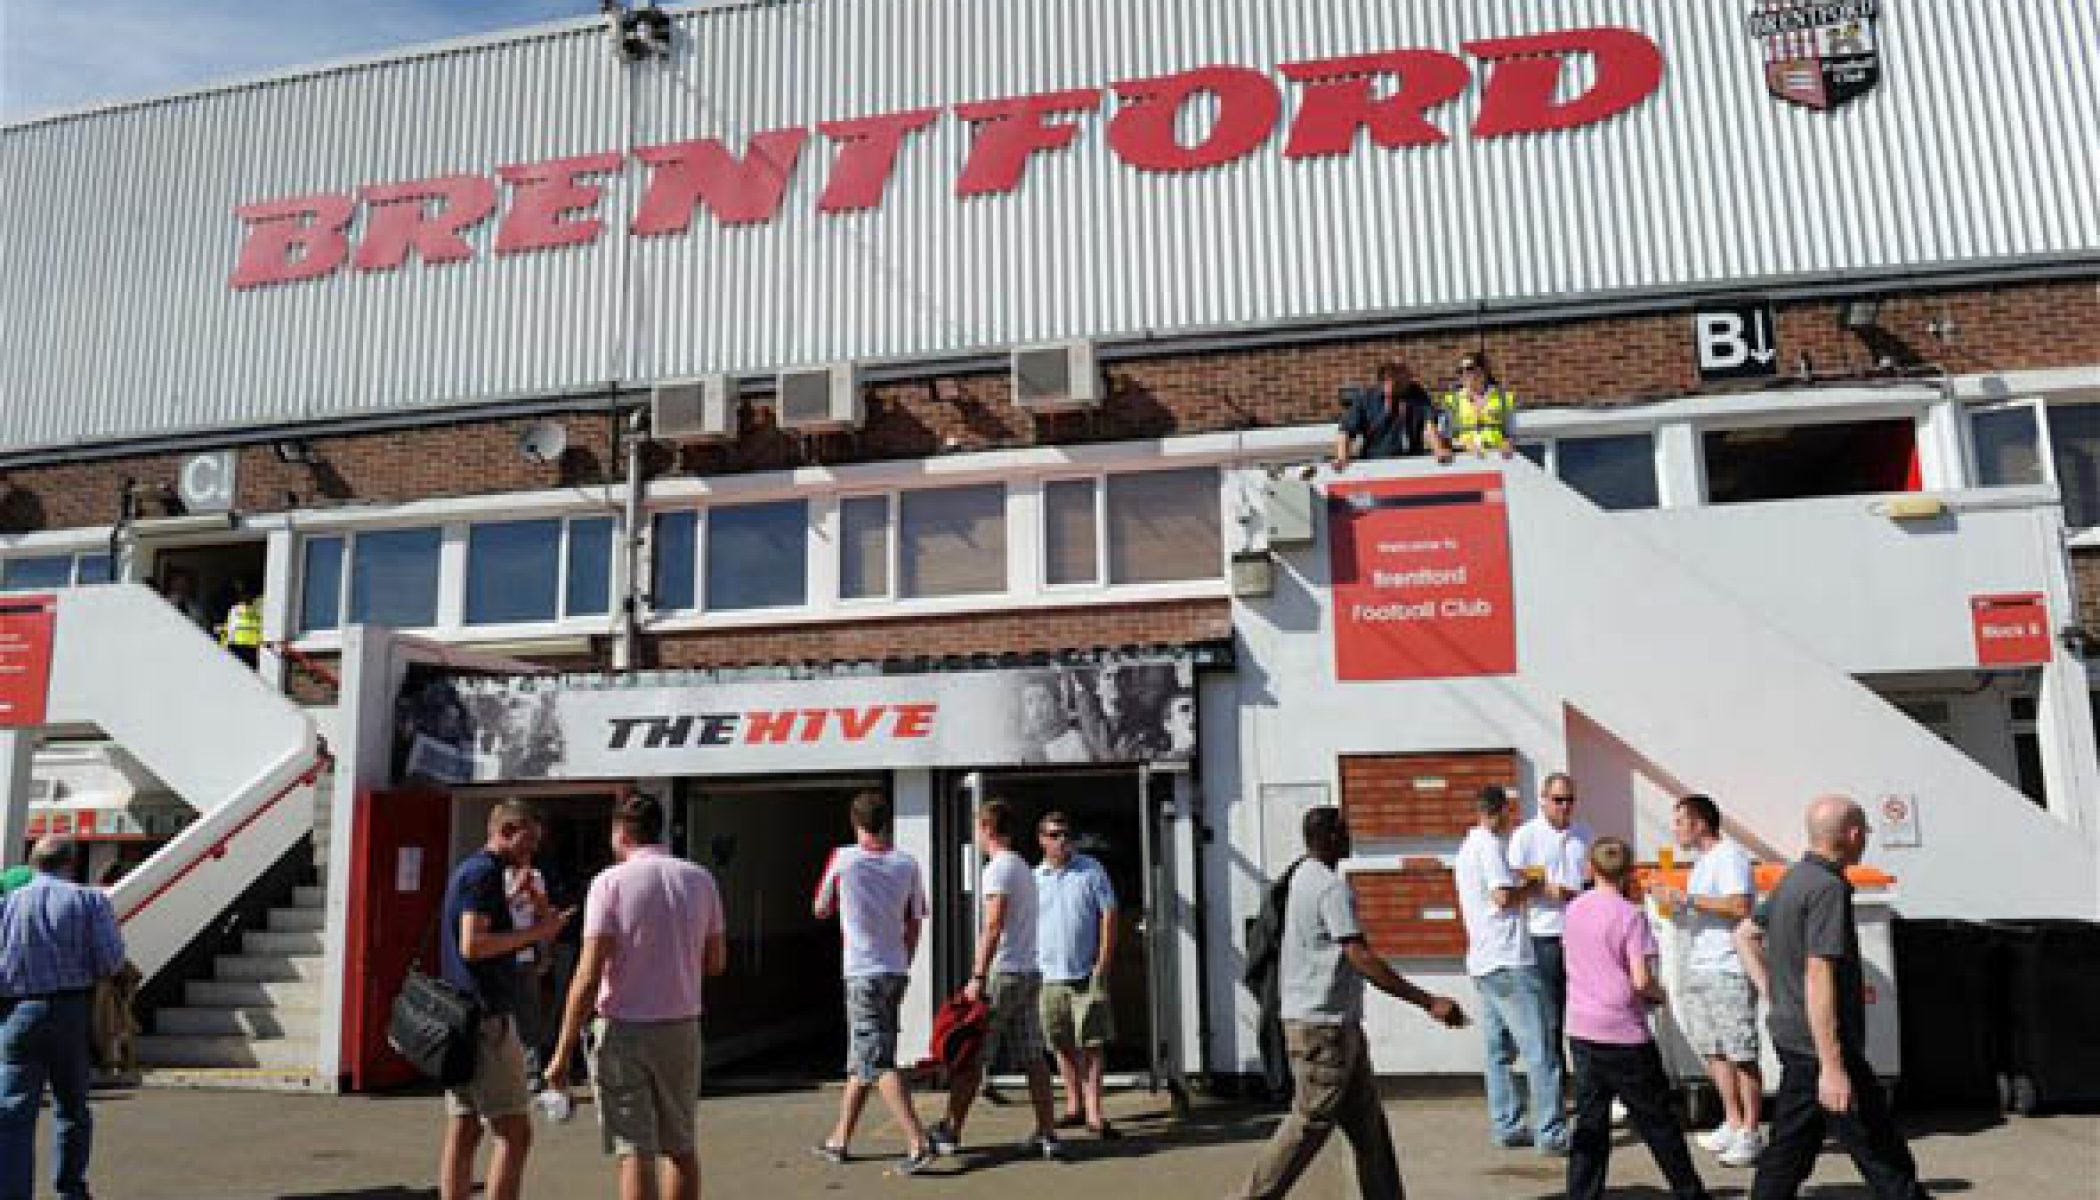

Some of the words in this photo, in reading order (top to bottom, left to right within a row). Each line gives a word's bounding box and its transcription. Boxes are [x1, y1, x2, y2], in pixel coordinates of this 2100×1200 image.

[229, 27, 1664, 291] BRENTFORD
[1698, 313, 1747, 368] B
[1373, 566, 1467, 588] Brentford
[1352, 601, 1435, 623] Football
[1441, 598, 1492, 617] Club
[608, 711, 740, 750] THE
[744, 703, 938, 746] HIVE
